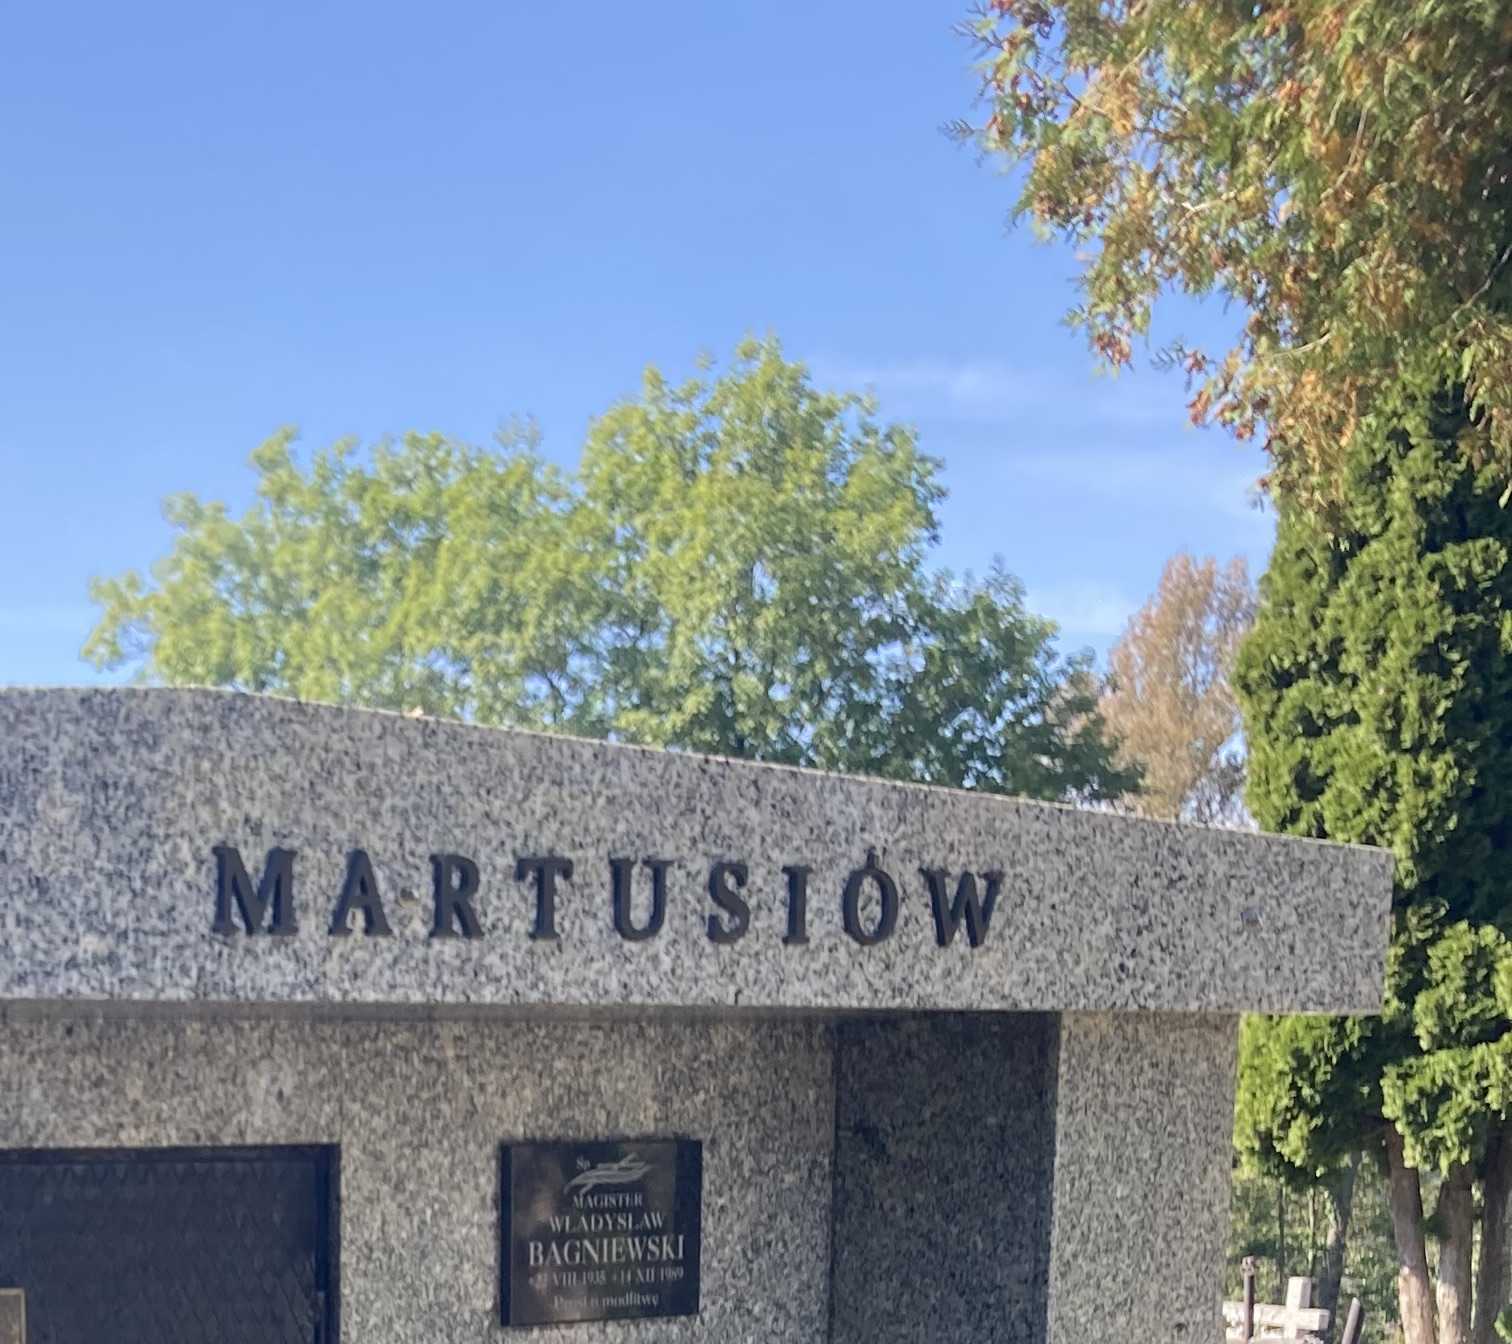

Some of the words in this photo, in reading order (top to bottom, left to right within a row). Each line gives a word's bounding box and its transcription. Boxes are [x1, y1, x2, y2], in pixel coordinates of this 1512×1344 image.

[210, 843, 1004, 949] MARTUSIÓW
[573, 1192, 643, 1209] MAGISTER
[529, 1235, 684, 1267] BAGNIEWSKI
